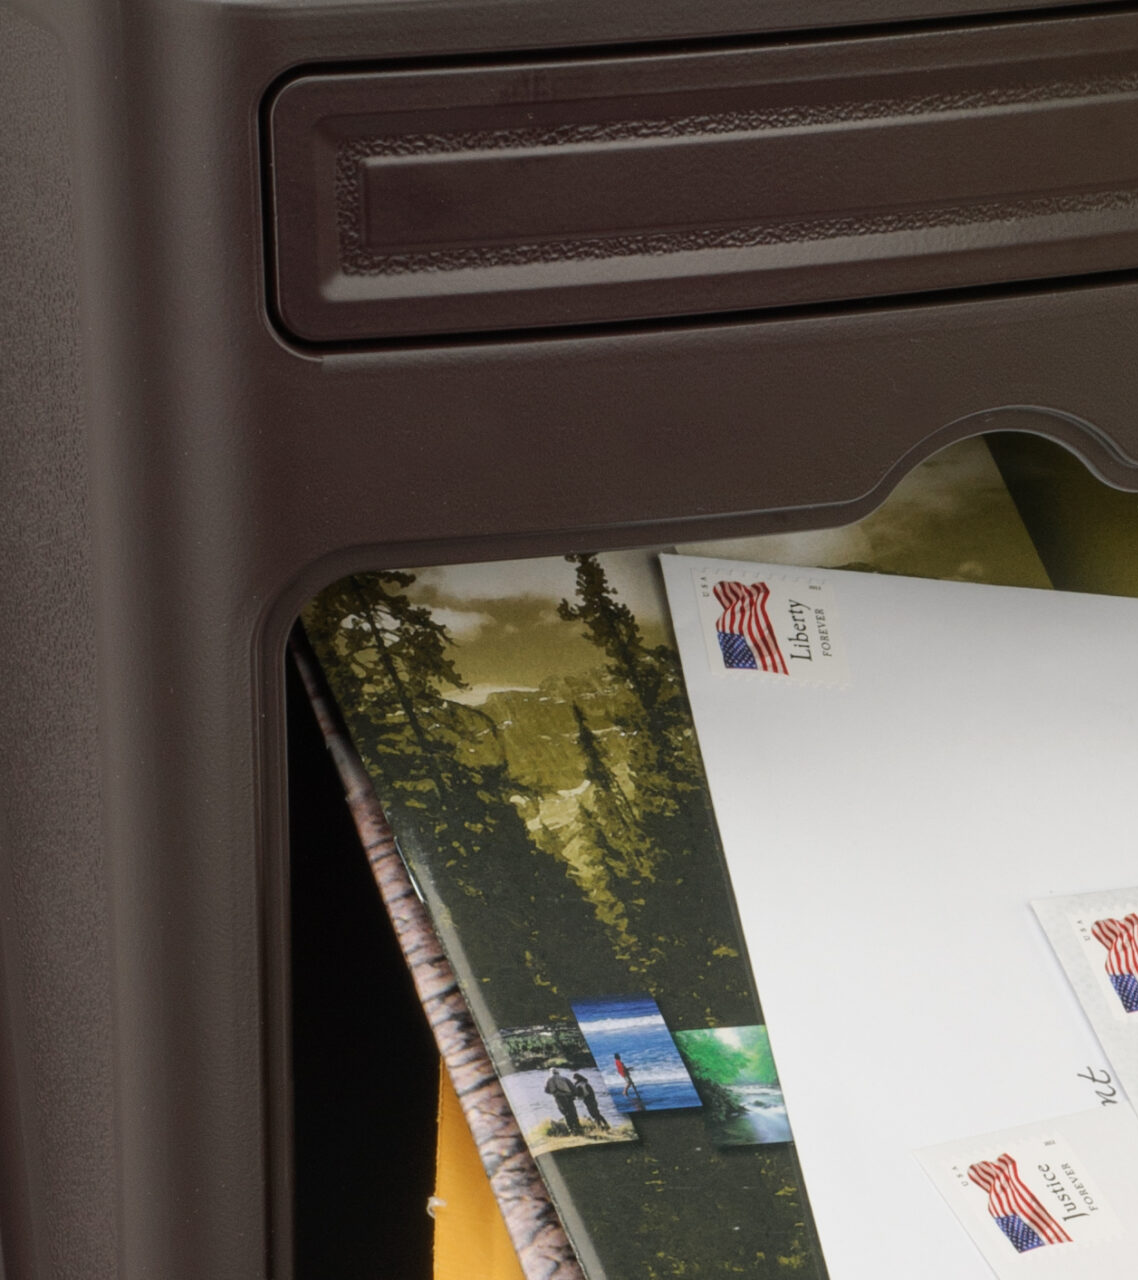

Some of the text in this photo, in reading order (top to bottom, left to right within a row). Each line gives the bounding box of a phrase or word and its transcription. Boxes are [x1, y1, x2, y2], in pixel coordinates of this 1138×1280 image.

[698, 576, 710, 598] USA
[788, 599, 812, 662] Liberty
[815, 608, 832, 657] FOREVER
[1076, 920, 1090, 942] USA
[951, 1166, 969, 1187] USA
[1038, 1163, 1090, 1222] Justice
[1061, 1162, 1098, 1211] FOREVER
